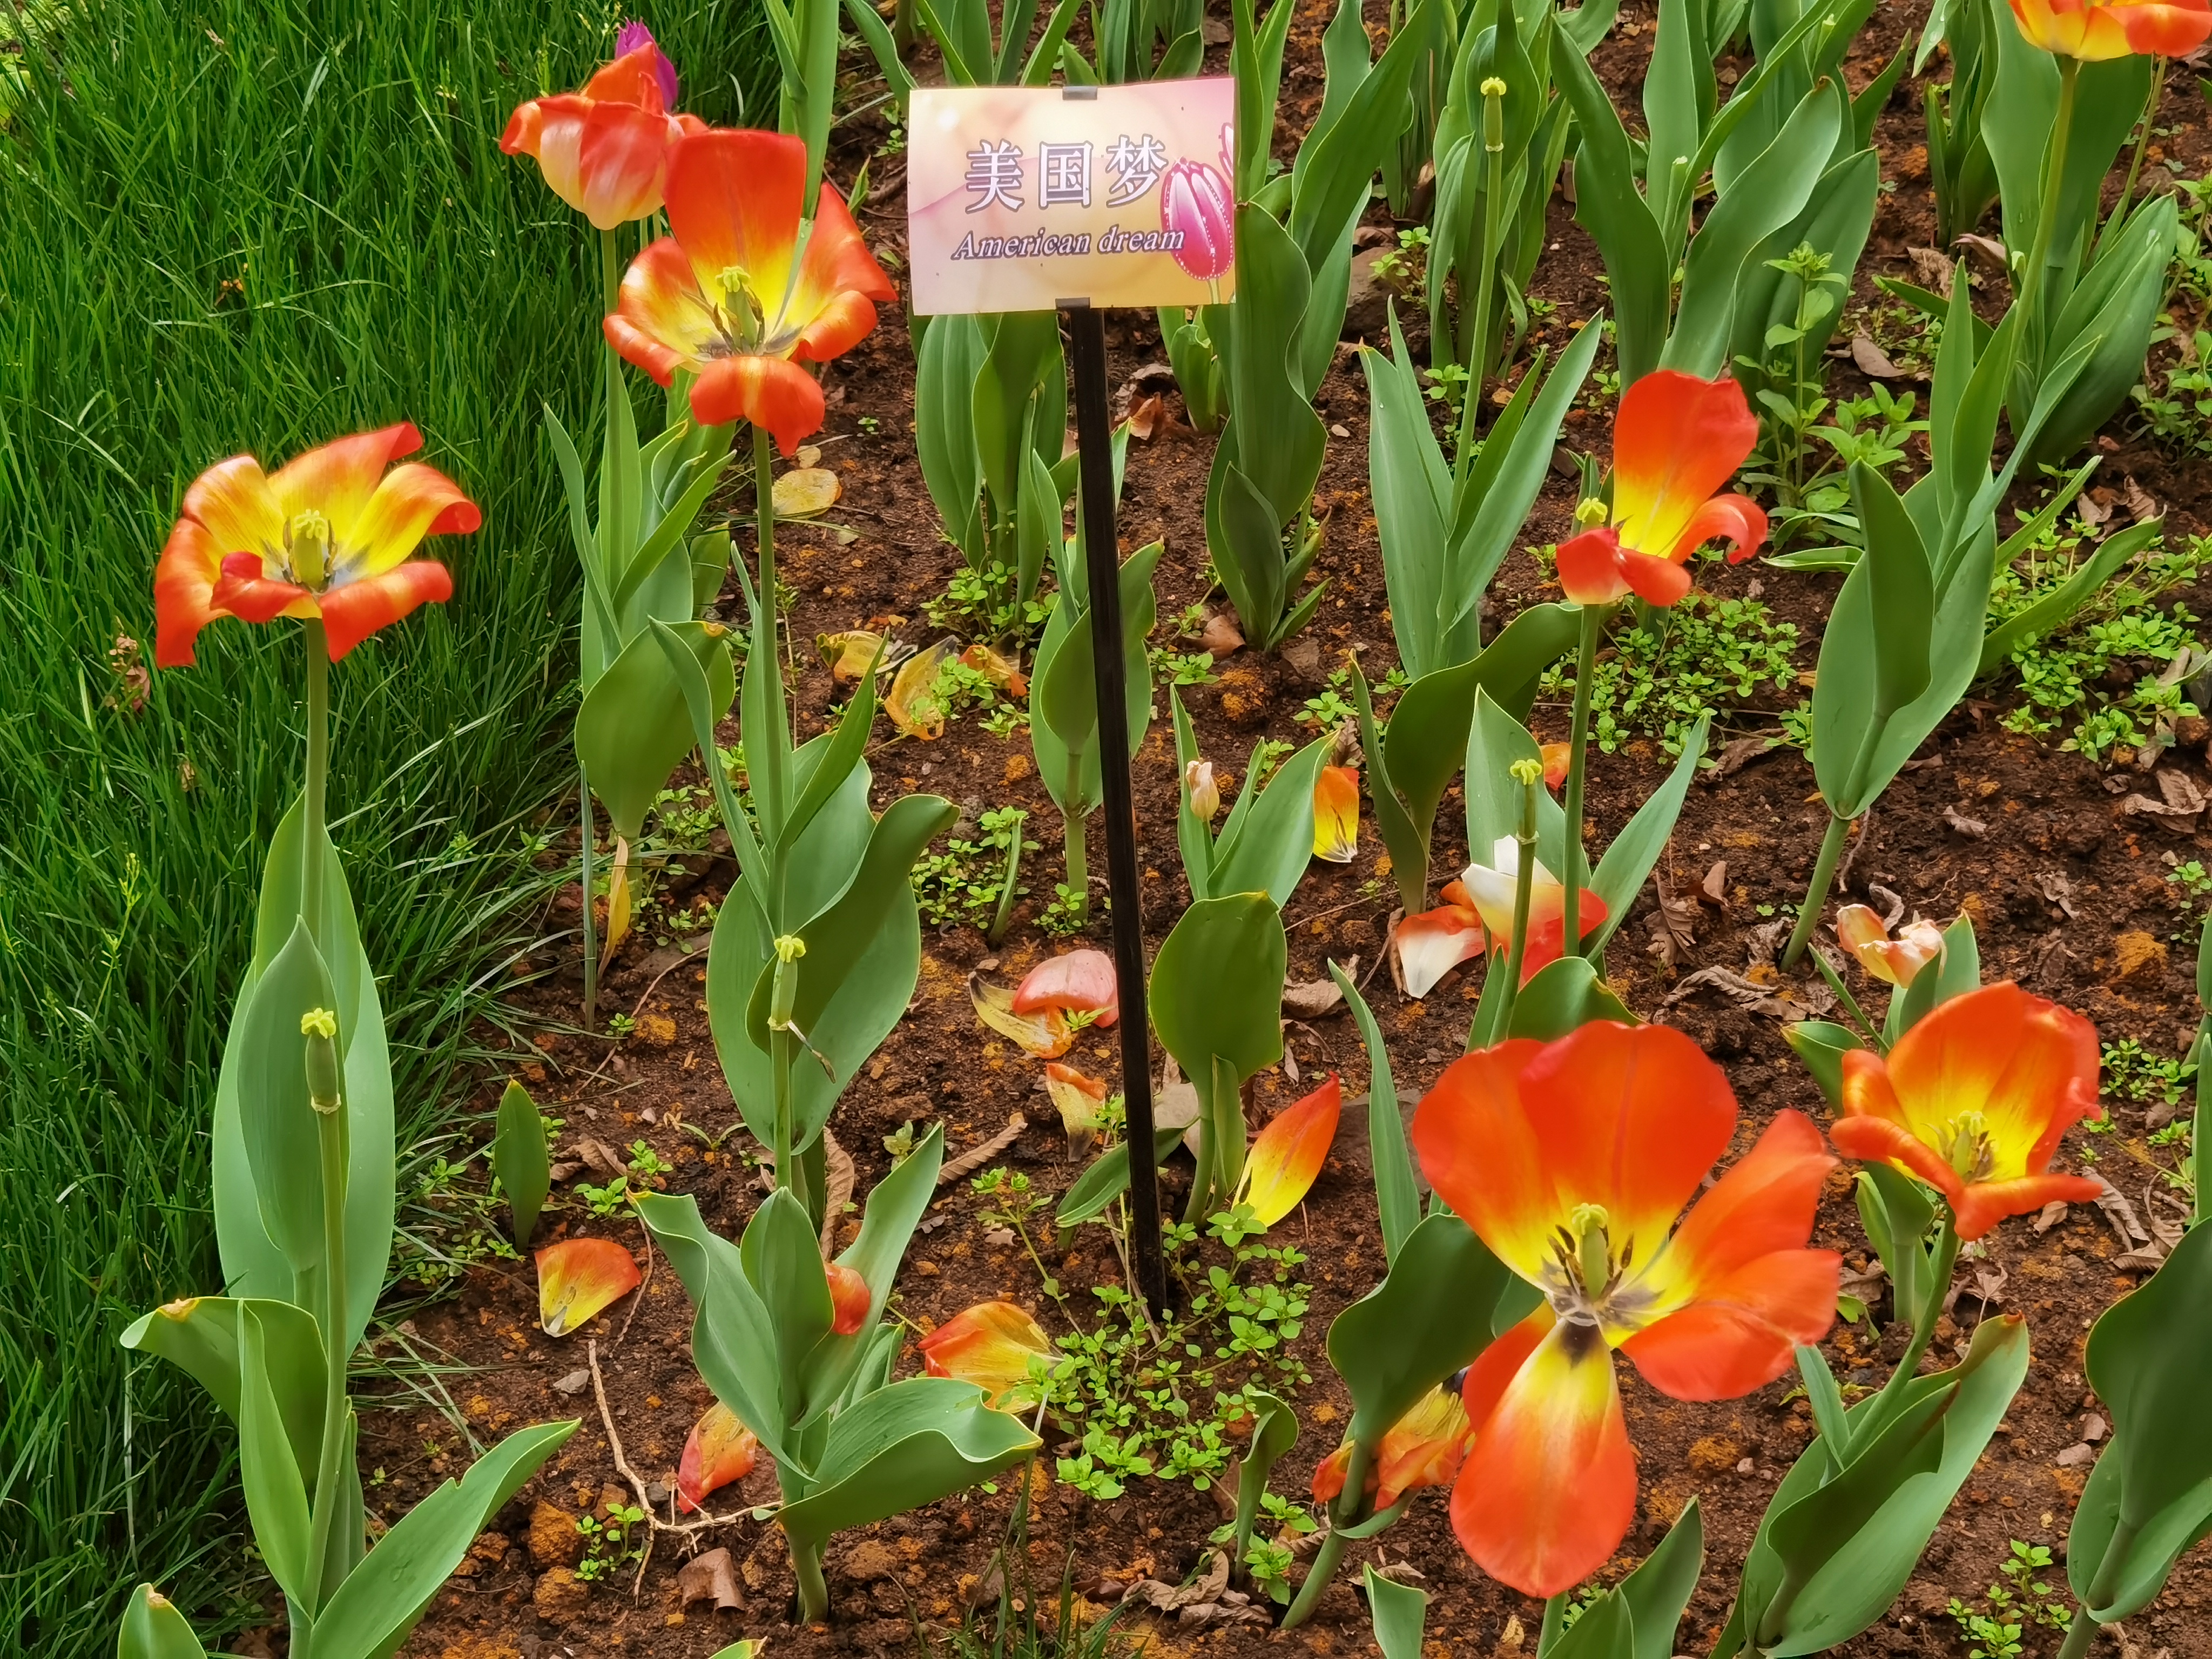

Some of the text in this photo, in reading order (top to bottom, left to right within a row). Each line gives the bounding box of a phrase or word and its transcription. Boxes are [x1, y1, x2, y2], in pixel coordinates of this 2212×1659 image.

[966, 134, 1168, 213] 美国梦
[952, 225, 1185, 260] American dream
